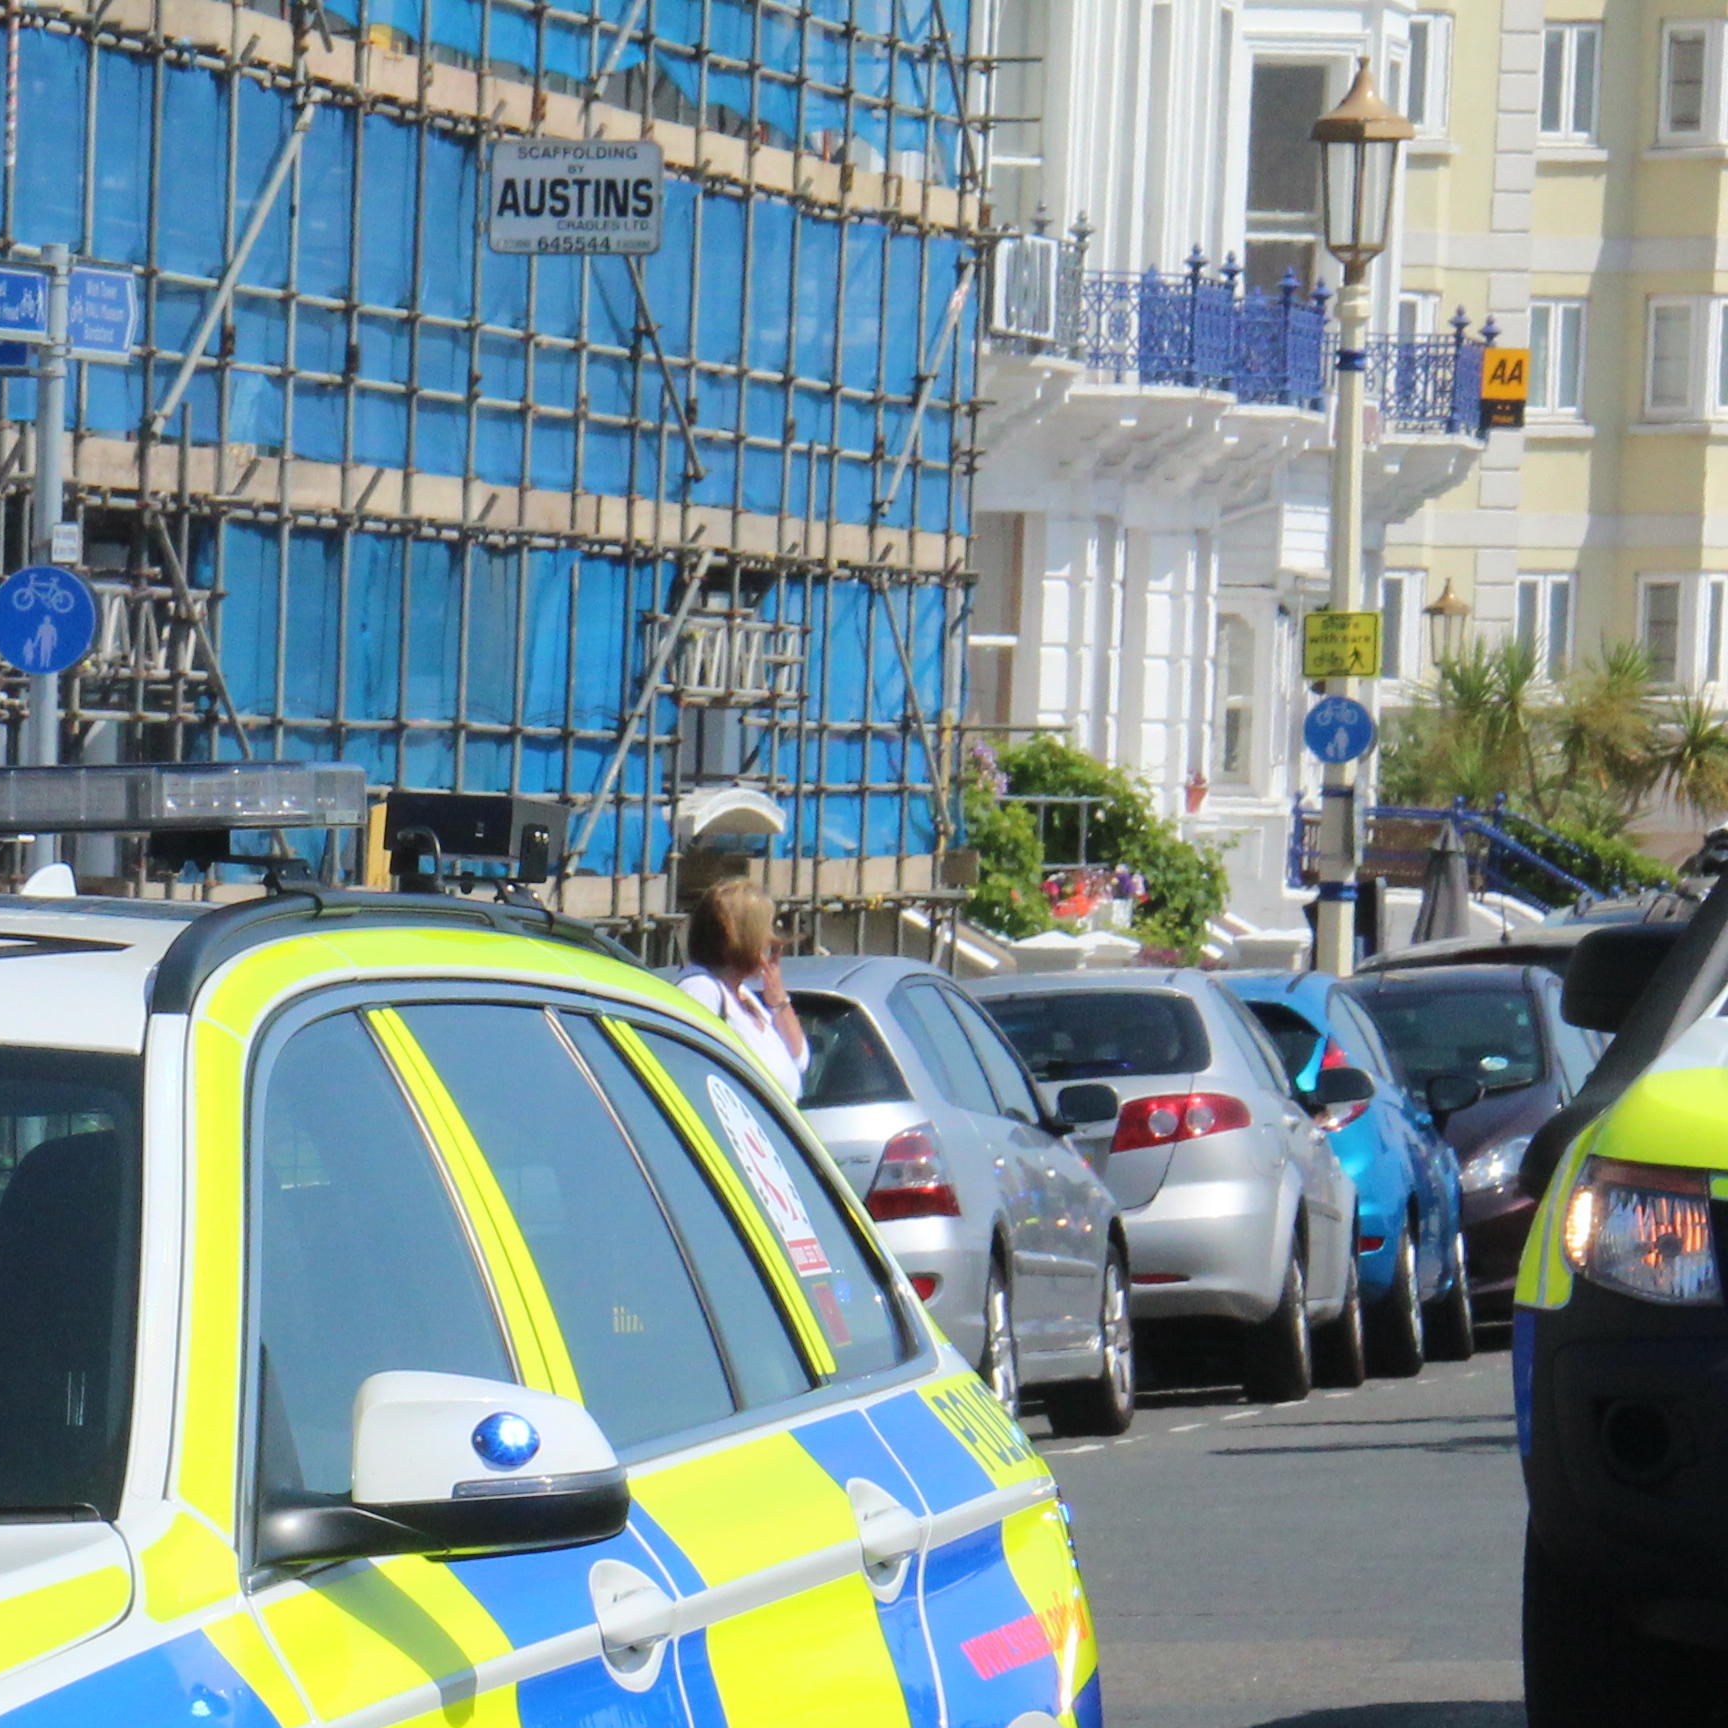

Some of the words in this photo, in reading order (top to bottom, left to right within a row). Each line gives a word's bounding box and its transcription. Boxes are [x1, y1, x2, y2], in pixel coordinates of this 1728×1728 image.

[518, 146, 638, 160] SCAFFOLDING
[568, 163, 585, 174] BY
[497, 178, 654, 218] AUSTINS
[1489, 358, 1523, 385] AA
